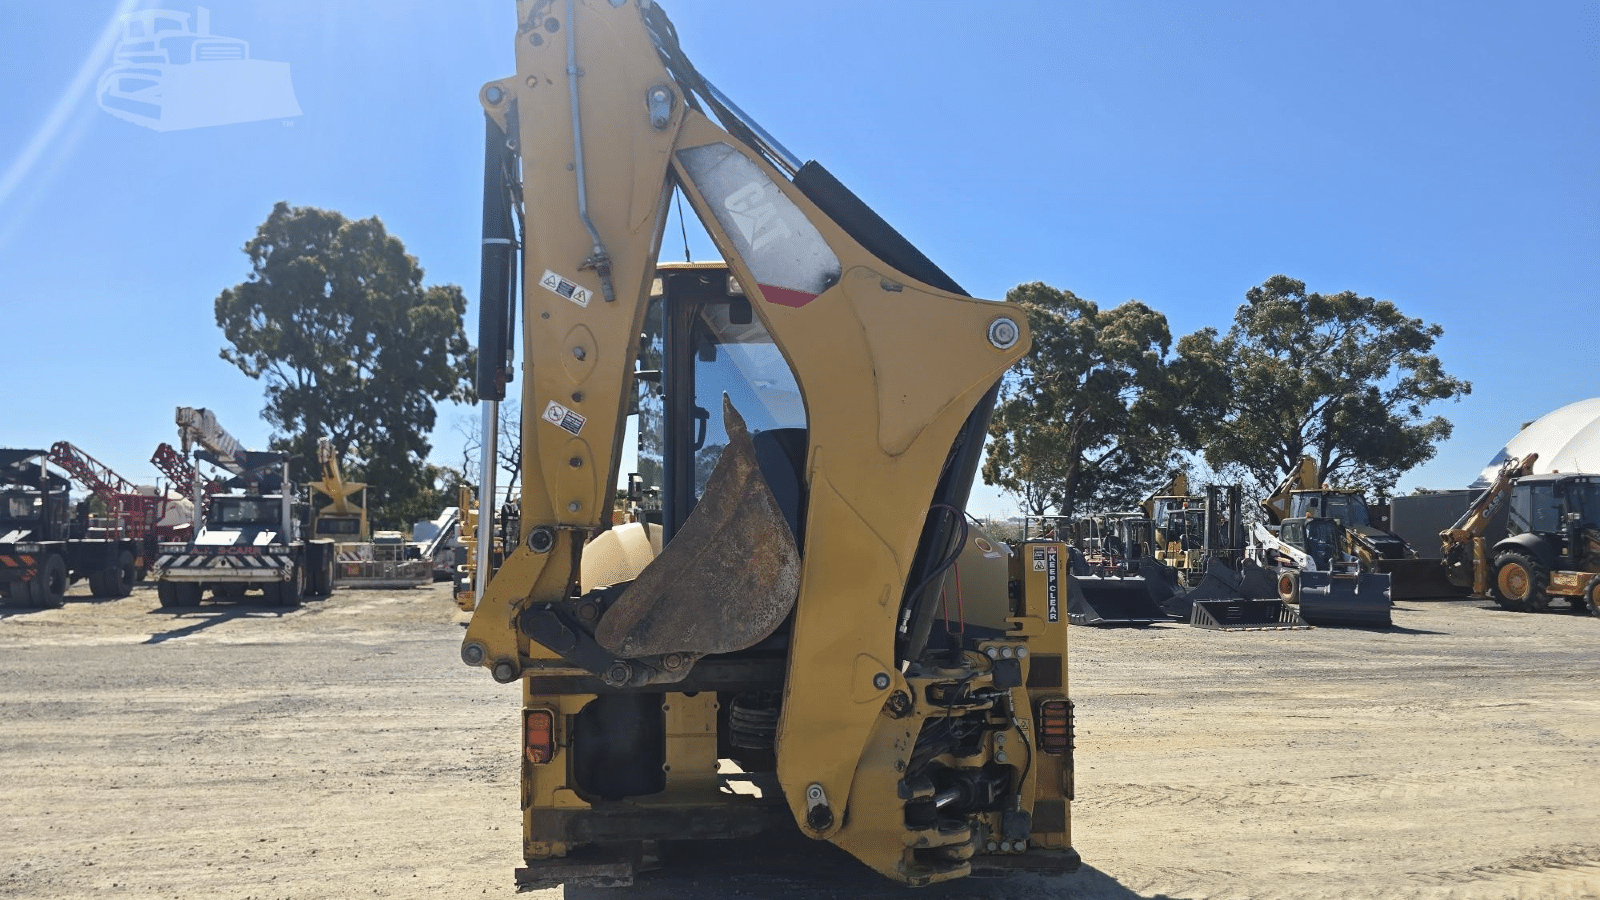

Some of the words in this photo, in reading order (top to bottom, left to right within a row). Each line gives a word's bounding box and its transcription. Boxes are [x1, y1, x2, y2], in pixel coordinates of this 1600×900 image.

[724, 181, 792, 251] CAT
[1482, 489, 1506, 518] CASE
[1048, 554, 1057, 583] KEEP
[1049, 585, 1057, 620] CLEAR
